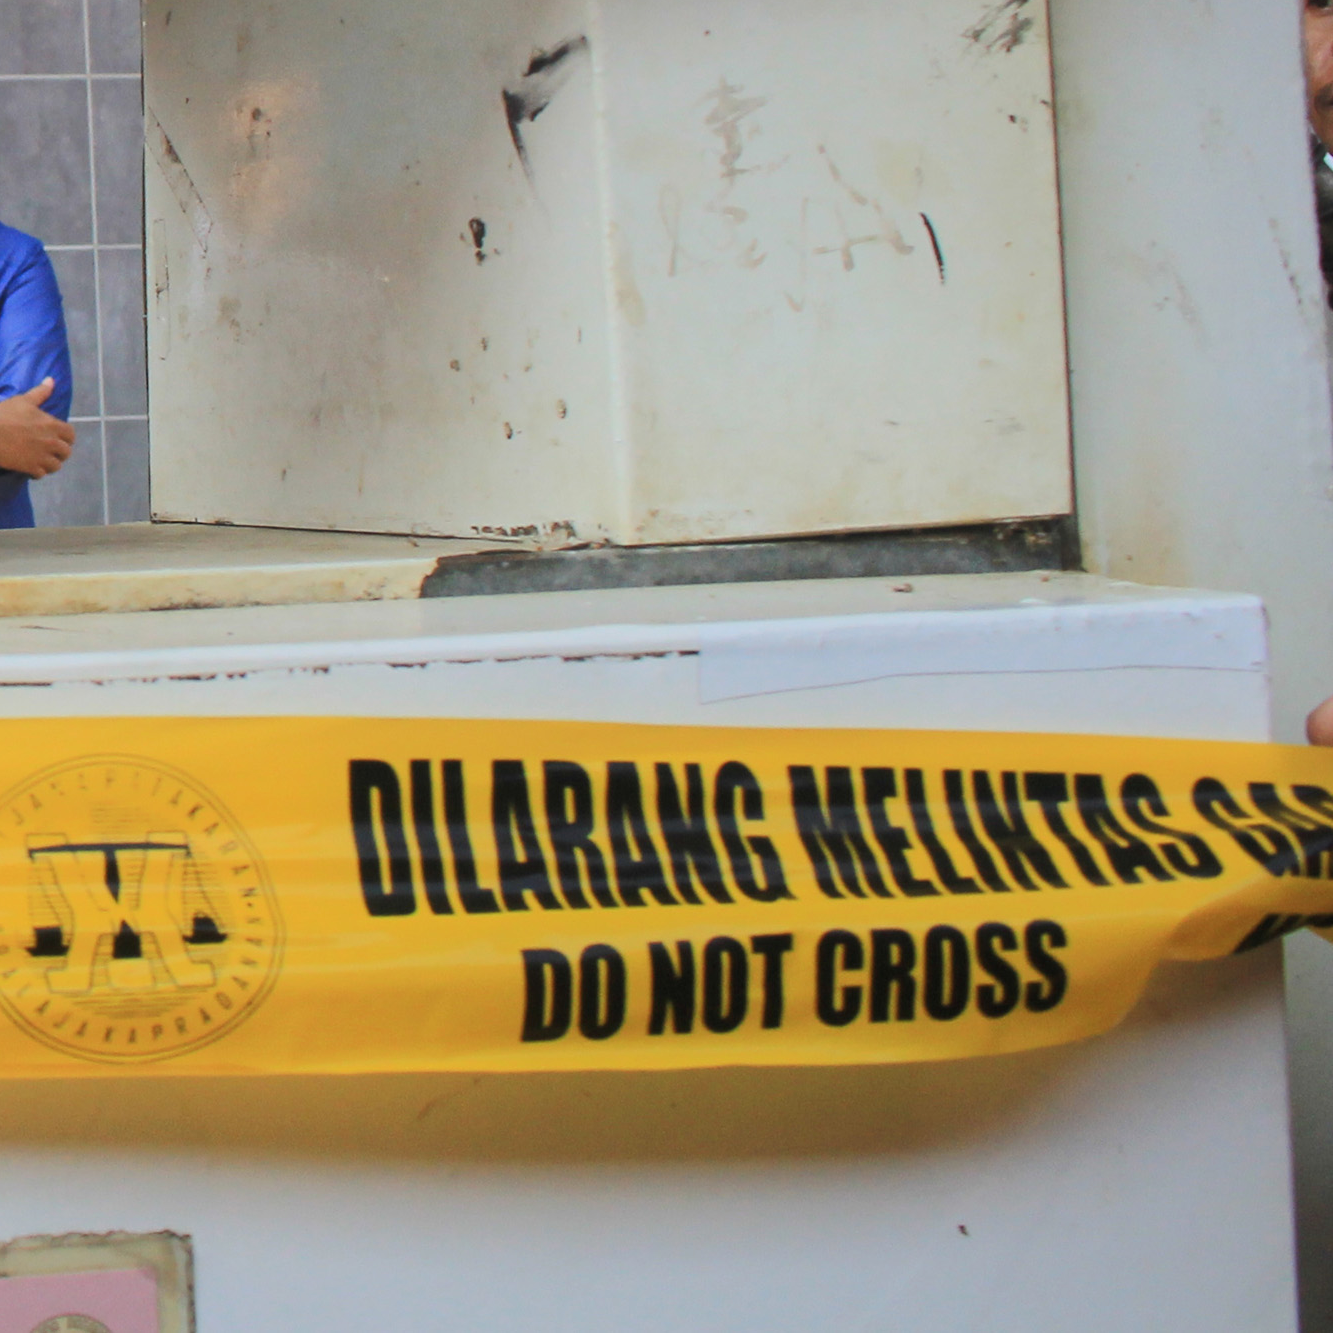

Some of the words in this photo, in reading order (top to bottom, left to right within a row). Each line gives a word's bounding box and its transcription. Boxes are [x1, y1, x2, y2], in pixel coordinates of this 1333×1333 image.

[348, 757, 798, 917] DILARANG
[786, 763, 1225, 901] MELINTAS
[520, 944, 627, 1044] DO
[646, 933, 794, 1036] NOT
[814, 919, 1069, 1028] CROSS
